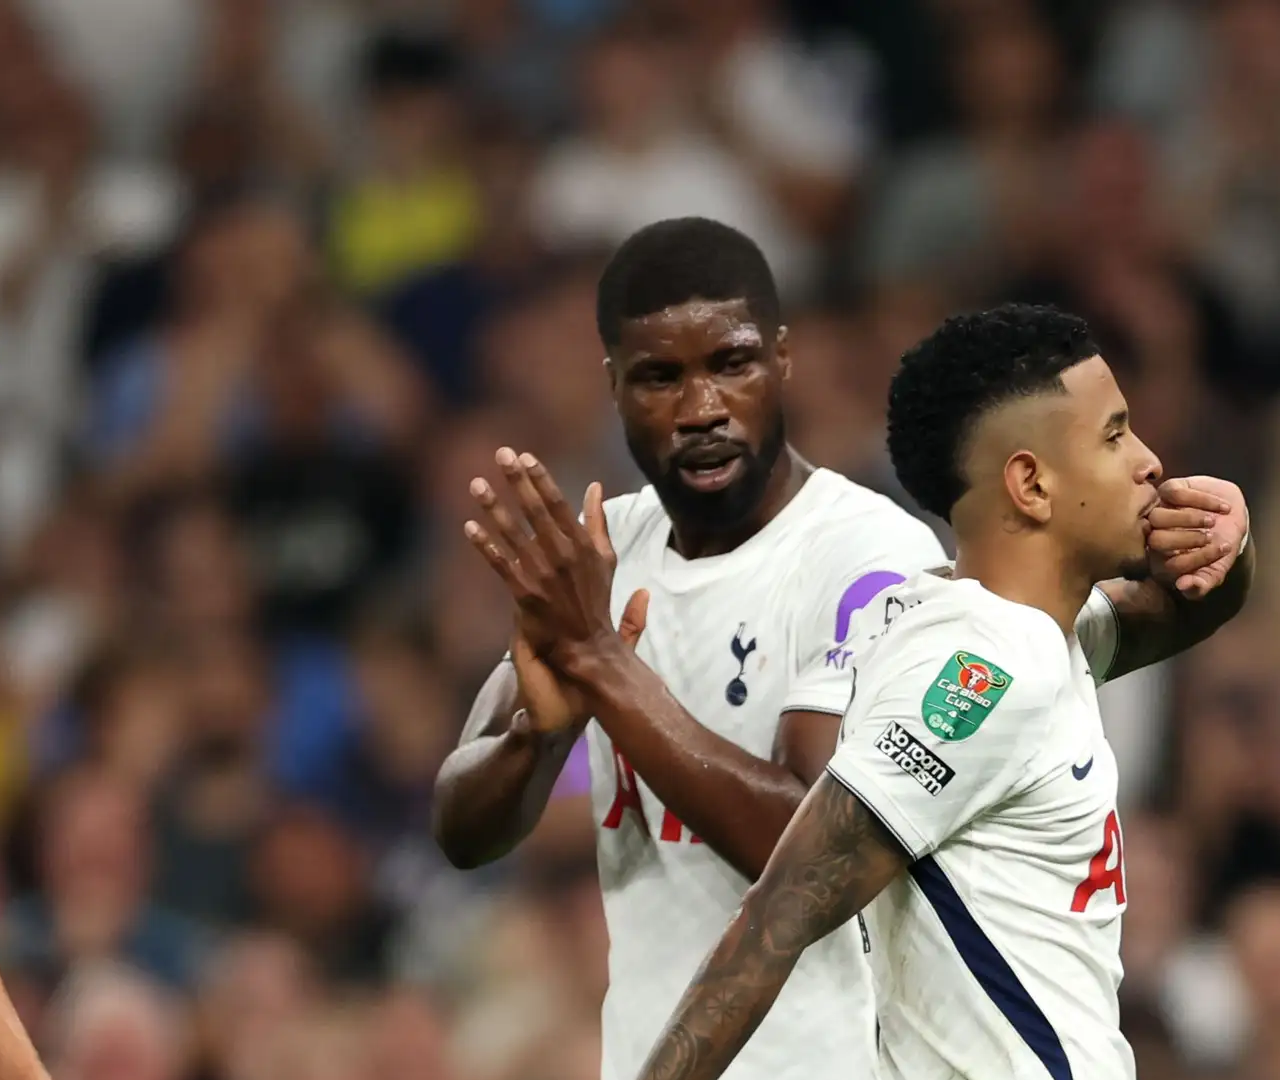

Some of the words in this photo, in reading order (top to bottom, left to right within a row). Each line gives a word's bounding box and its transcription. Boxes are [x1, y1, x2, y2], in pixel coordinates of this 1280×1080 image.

[937, 678, 992, 708] Carabao
[944, 692, 972, 712] Cup
[940, 722, 956, 737] EFL
[882, 721, 909, 748] No
[905, 742, 947, 780] room
[894, 751, 942, 797] racism
